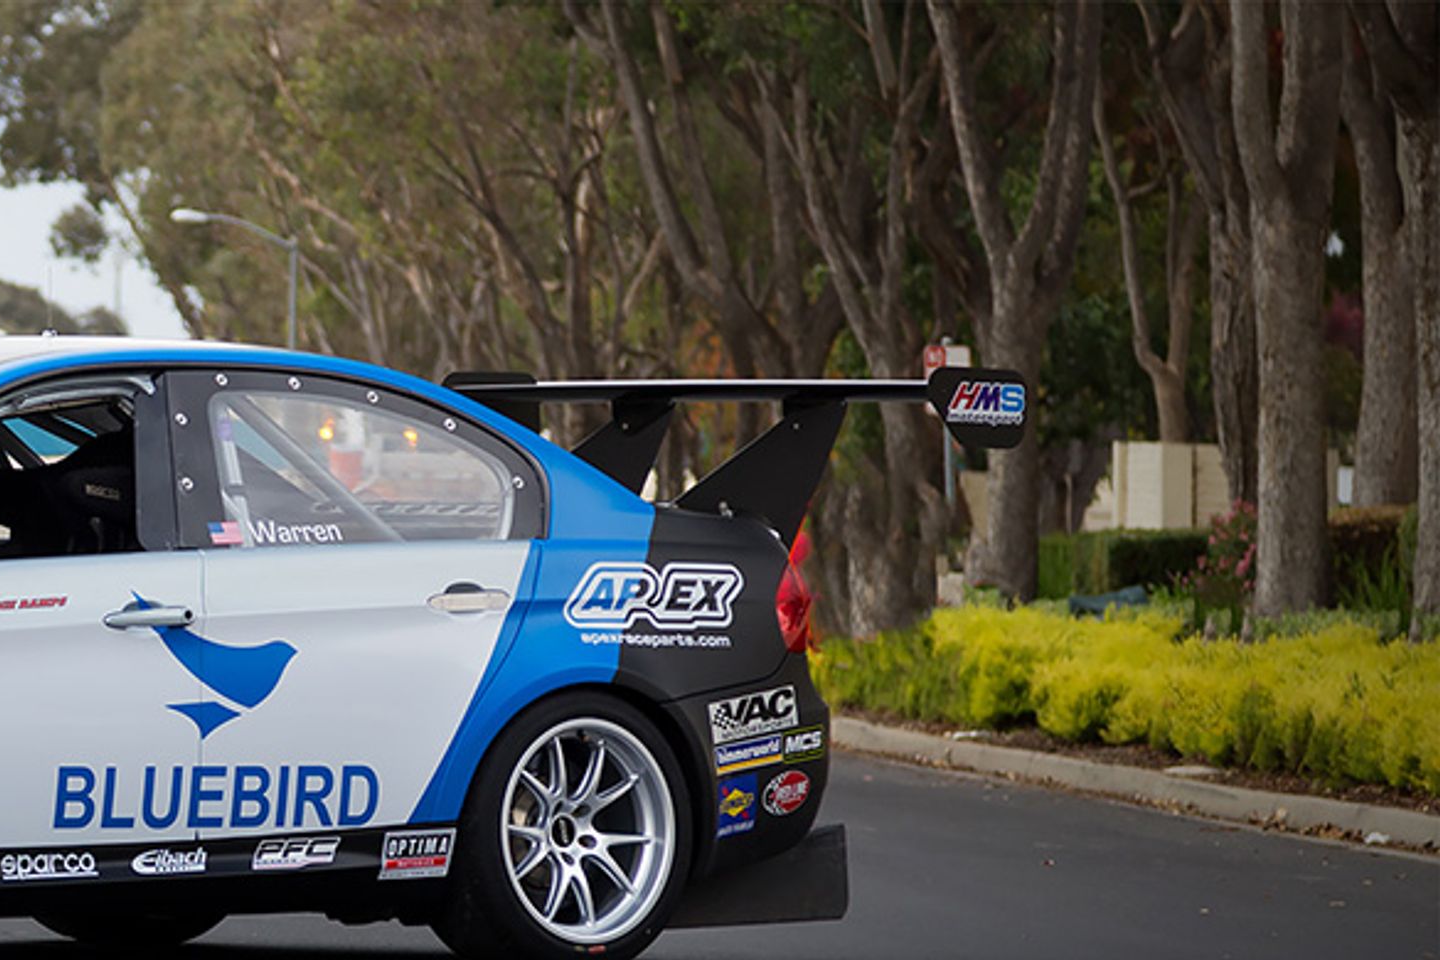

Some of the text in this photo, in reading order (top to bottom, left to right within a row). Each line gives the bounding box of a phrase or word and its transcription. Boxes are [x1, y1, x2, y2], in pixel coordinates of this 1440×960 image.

[949, 382, 1025, 412] HMS
[247, 521, 342, 543] Warren
[574, 571, 734, 617] APEX
[718, 689, 793, 725] VAC
[785, 731, 822, 754] MCS
[53, 765, 379, 829] BLUEBIRD
[257, 837, 341, 862] PFC
[388, 836, 447, 856] OPTIMA
[0, 852, 95, 878] sparco
[132, 847, 207, 875] Eibach
